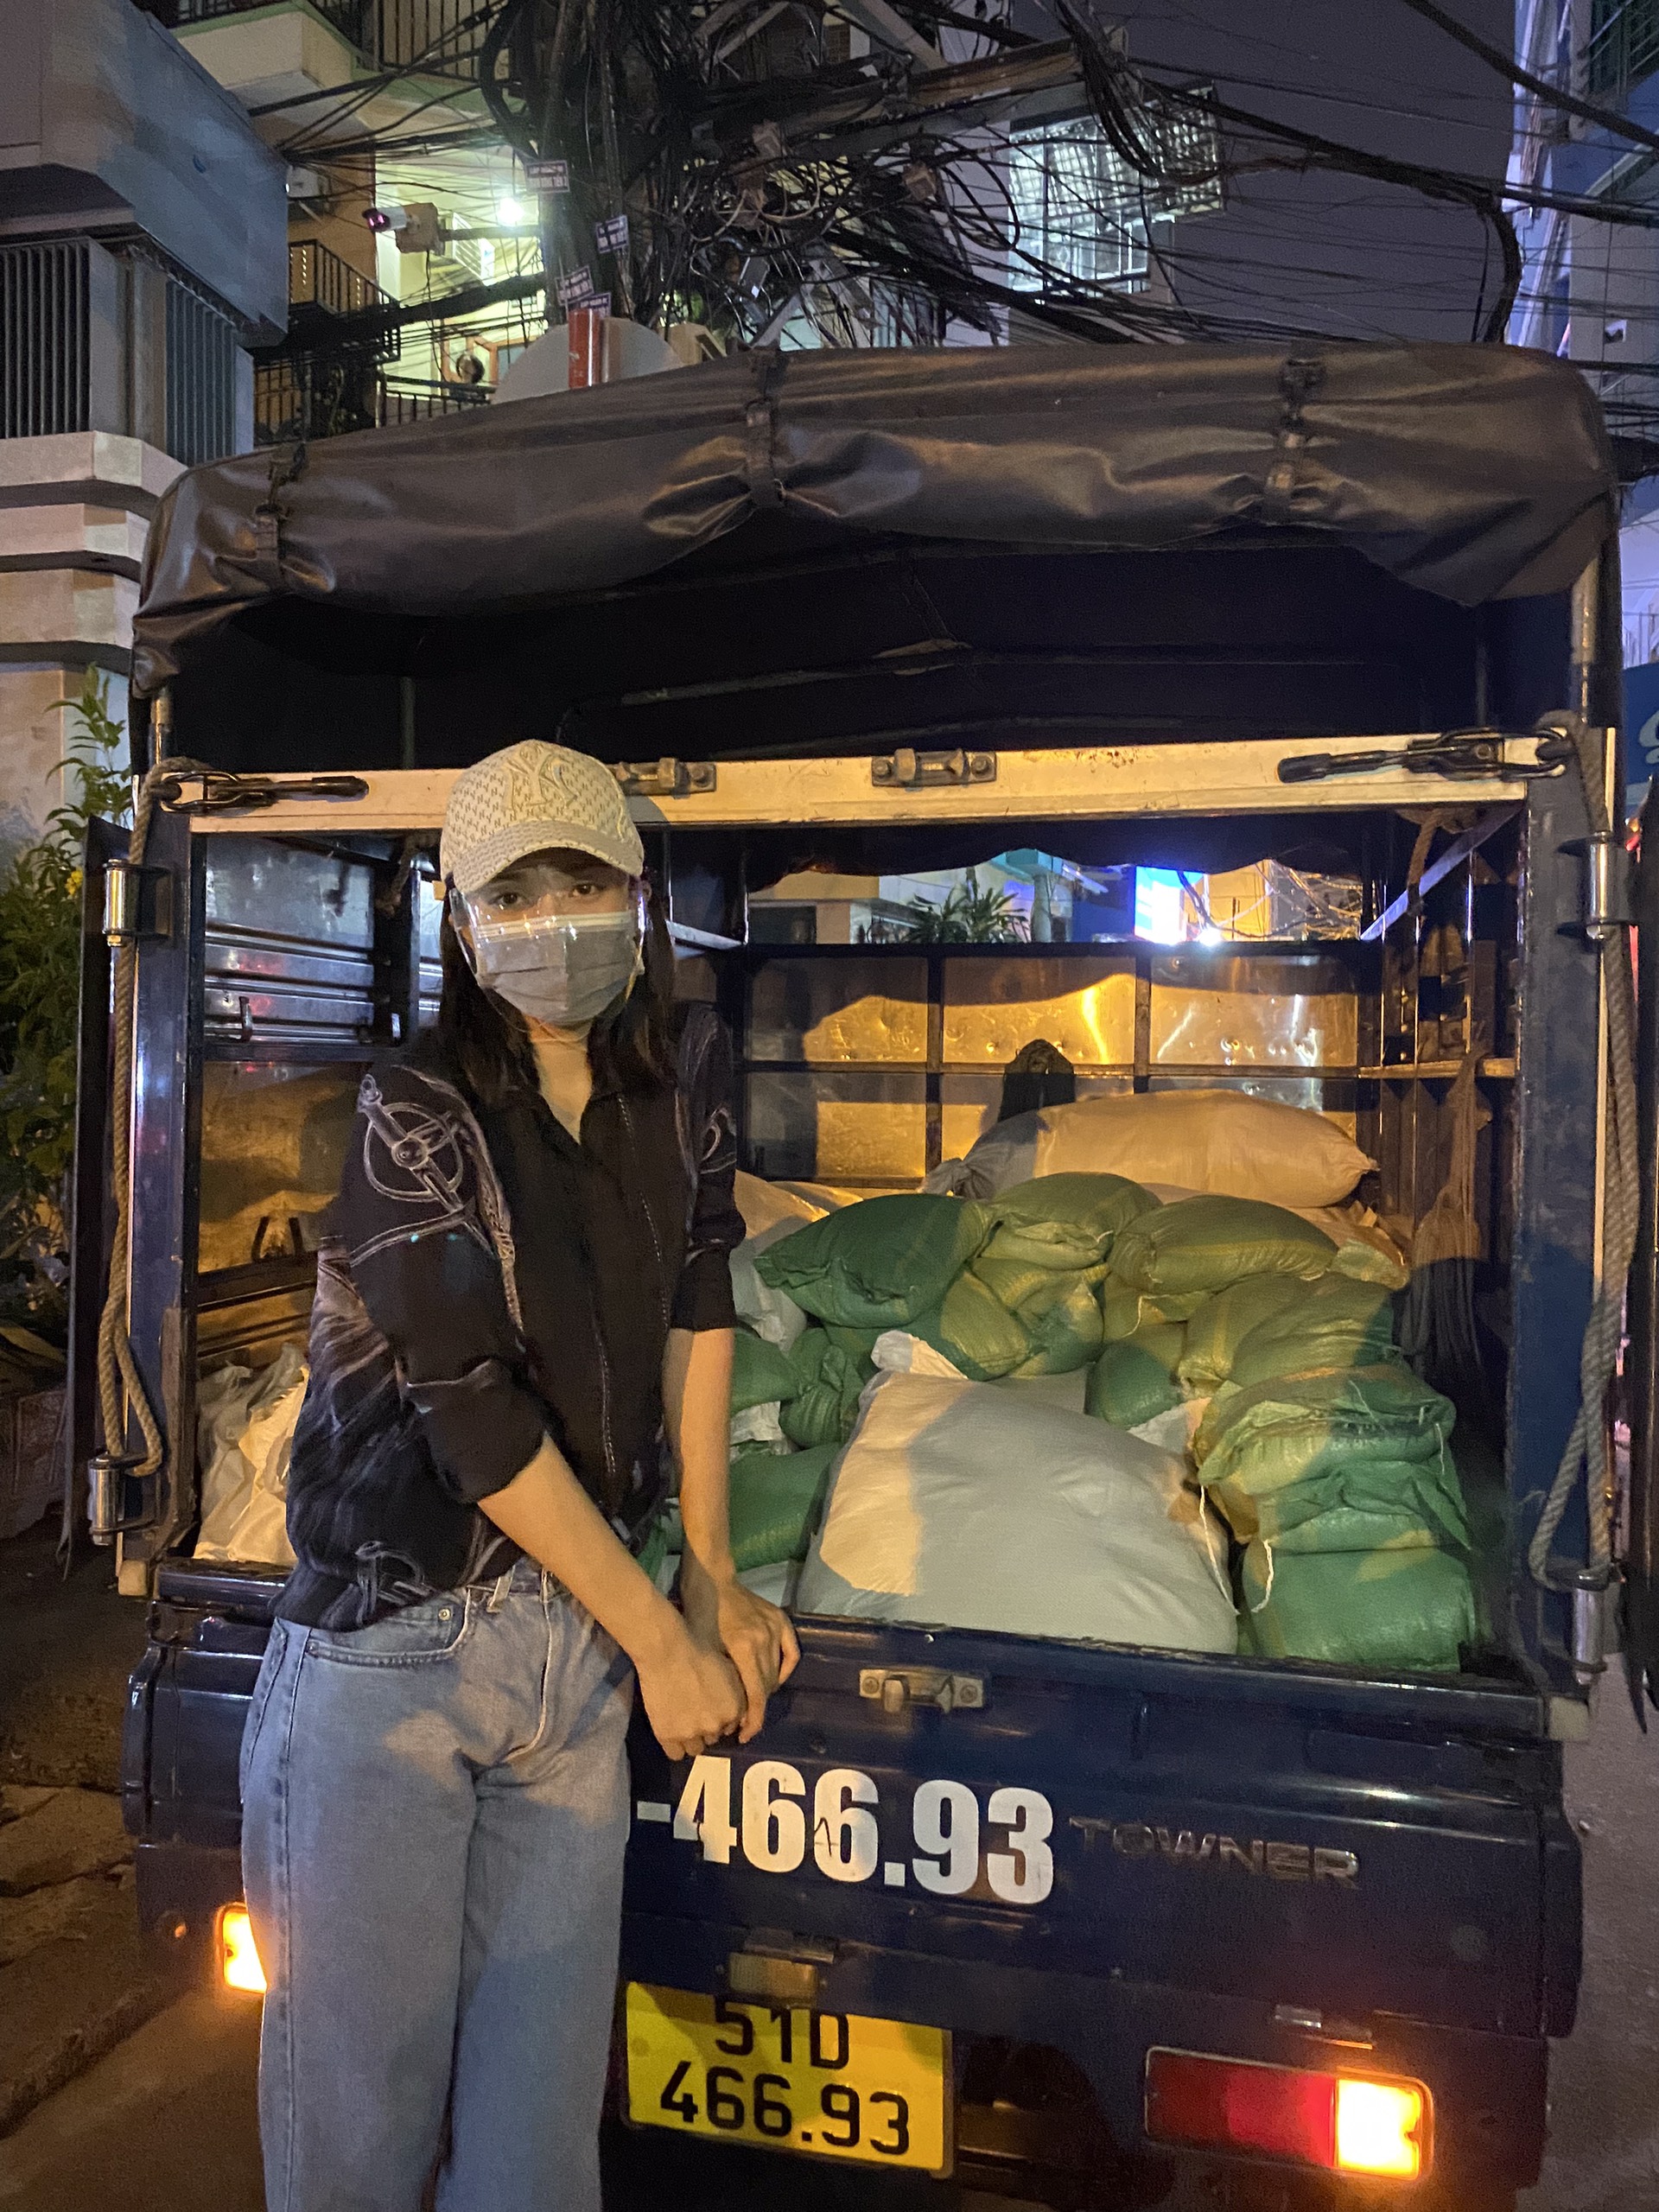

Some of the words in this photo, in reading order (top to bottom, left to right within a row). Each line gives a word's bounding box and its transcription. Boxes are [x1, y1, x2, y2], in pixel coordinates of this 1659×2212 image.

[1069, 1816, 1359, 1890] TOWNER
[714, 1993, 849, 2070] 51D
[660, 2060, 910, 2156] 466.93
